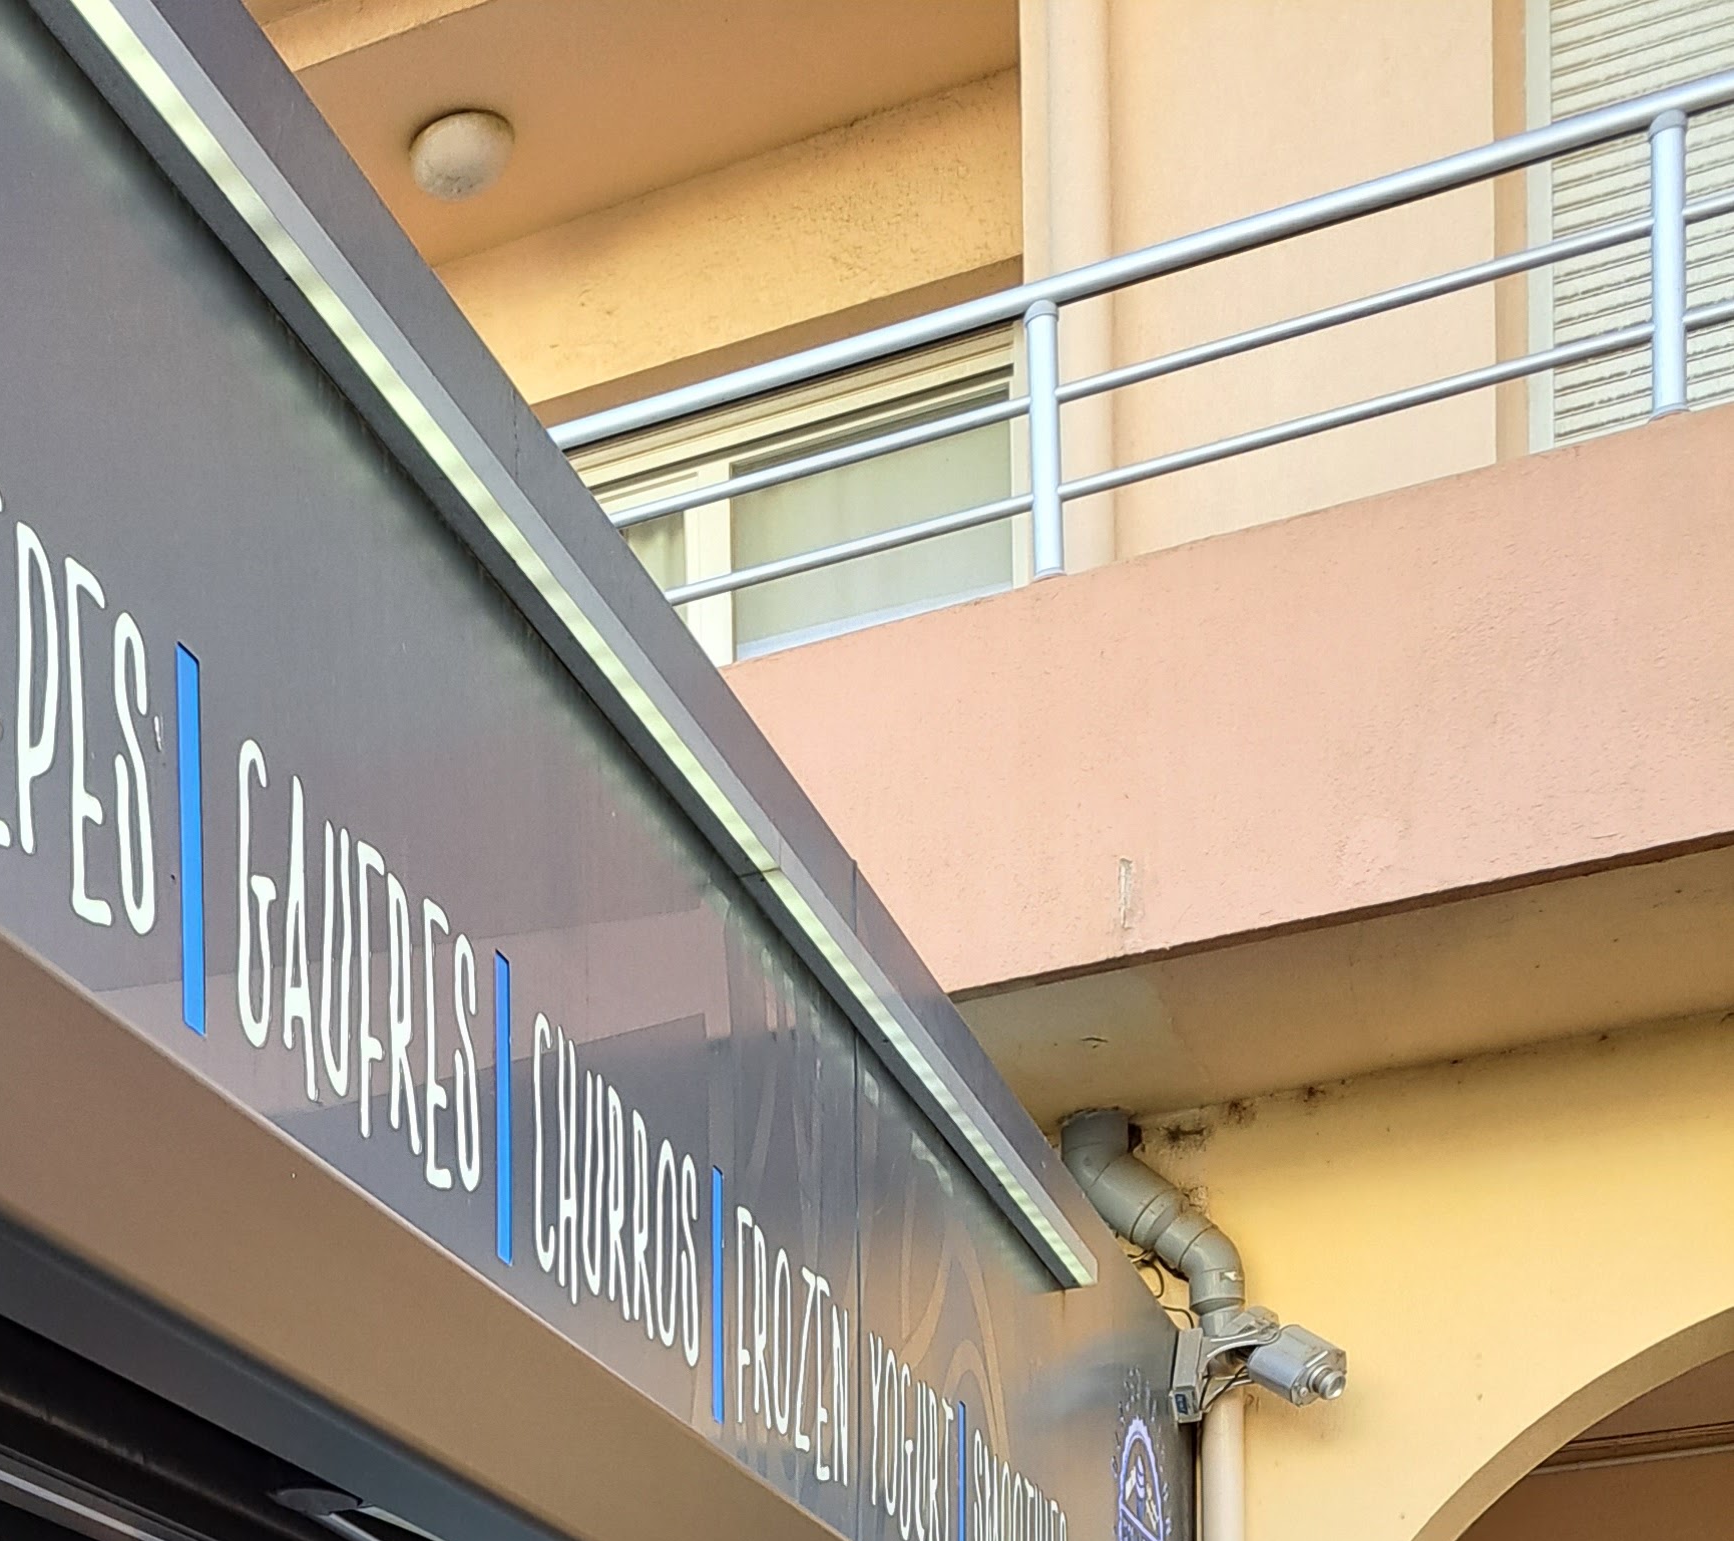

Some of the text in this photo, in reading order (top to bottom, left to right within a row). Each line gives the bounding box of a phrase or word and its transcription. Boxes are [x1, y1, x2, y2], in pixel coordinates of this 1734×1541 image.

[236, 739, 482, 1194] GAUFRES
[532, 1011, 701, 1370] CHURROS
[734, 1203, 853, 1489] FROZEN
